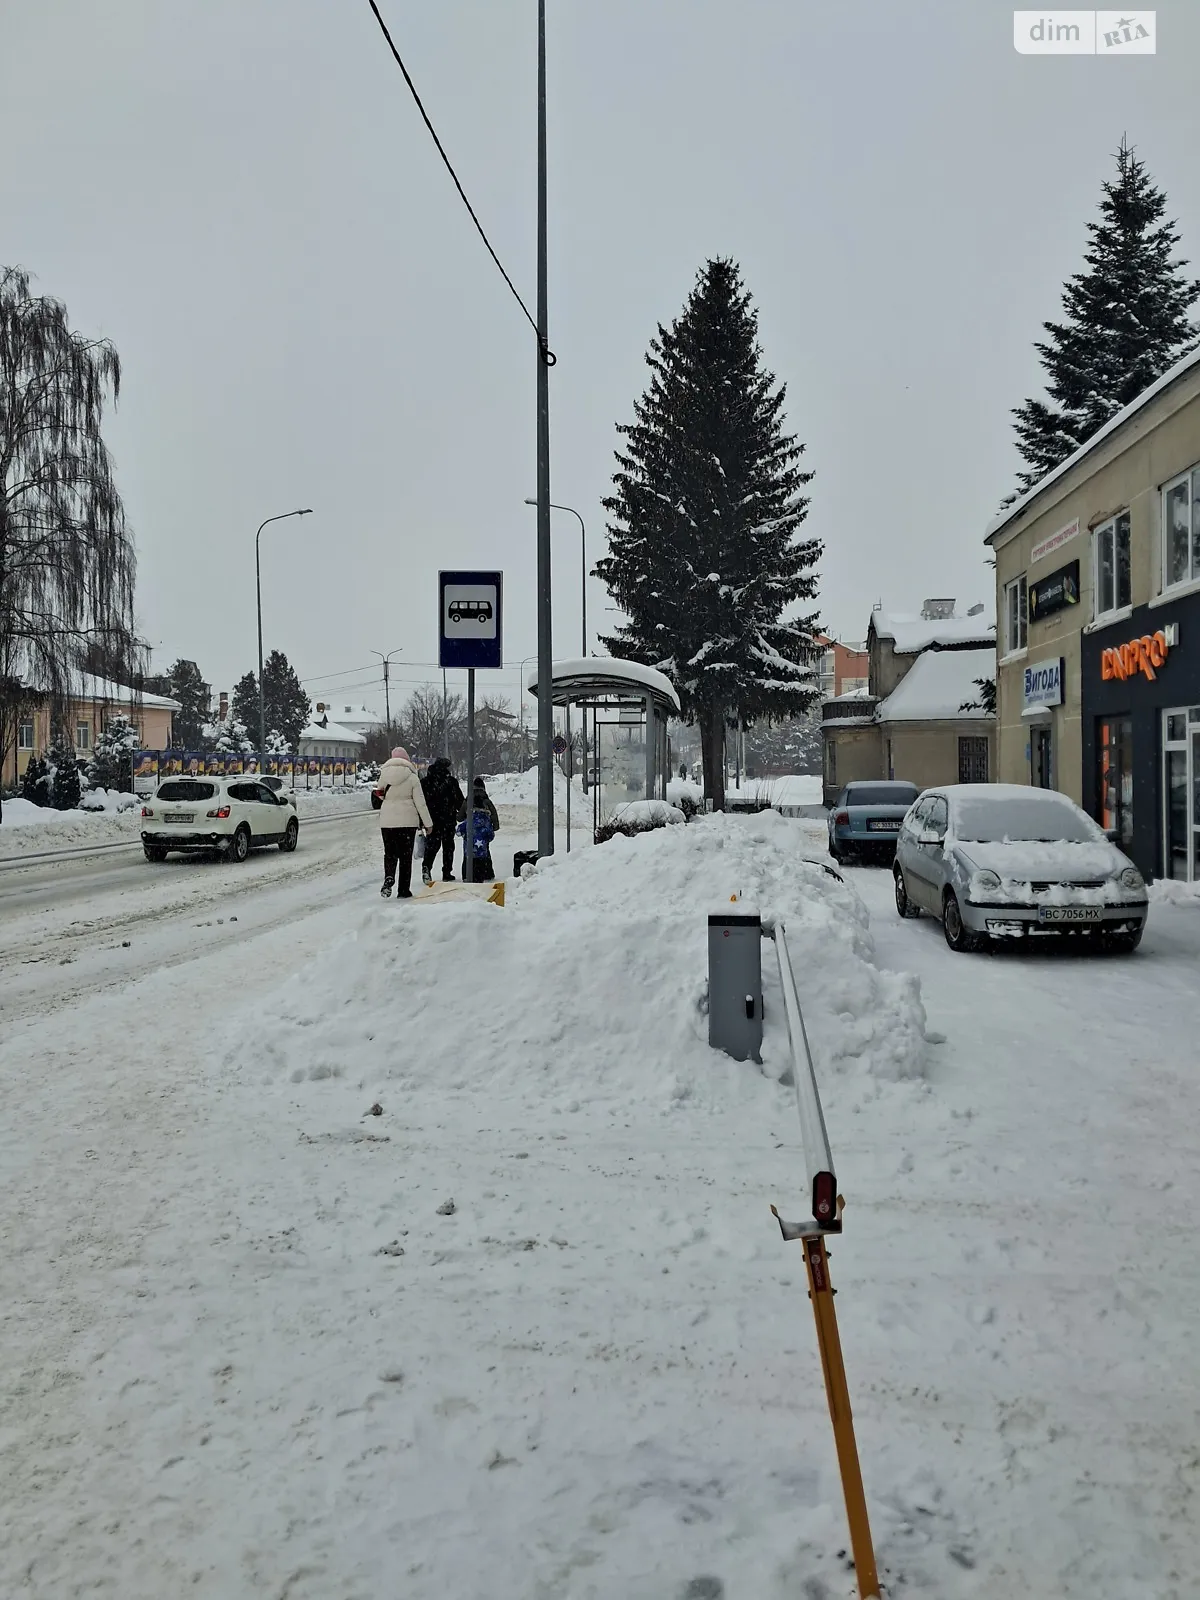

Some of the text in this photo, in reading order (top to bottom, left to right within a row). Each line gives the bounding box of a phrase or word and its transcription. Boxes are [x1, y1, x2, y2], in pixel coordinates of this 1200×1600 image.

[1025, 666, 1060, 697] ВИГОДА
[1045, 909, 1099, 919] BC 7056 MX
